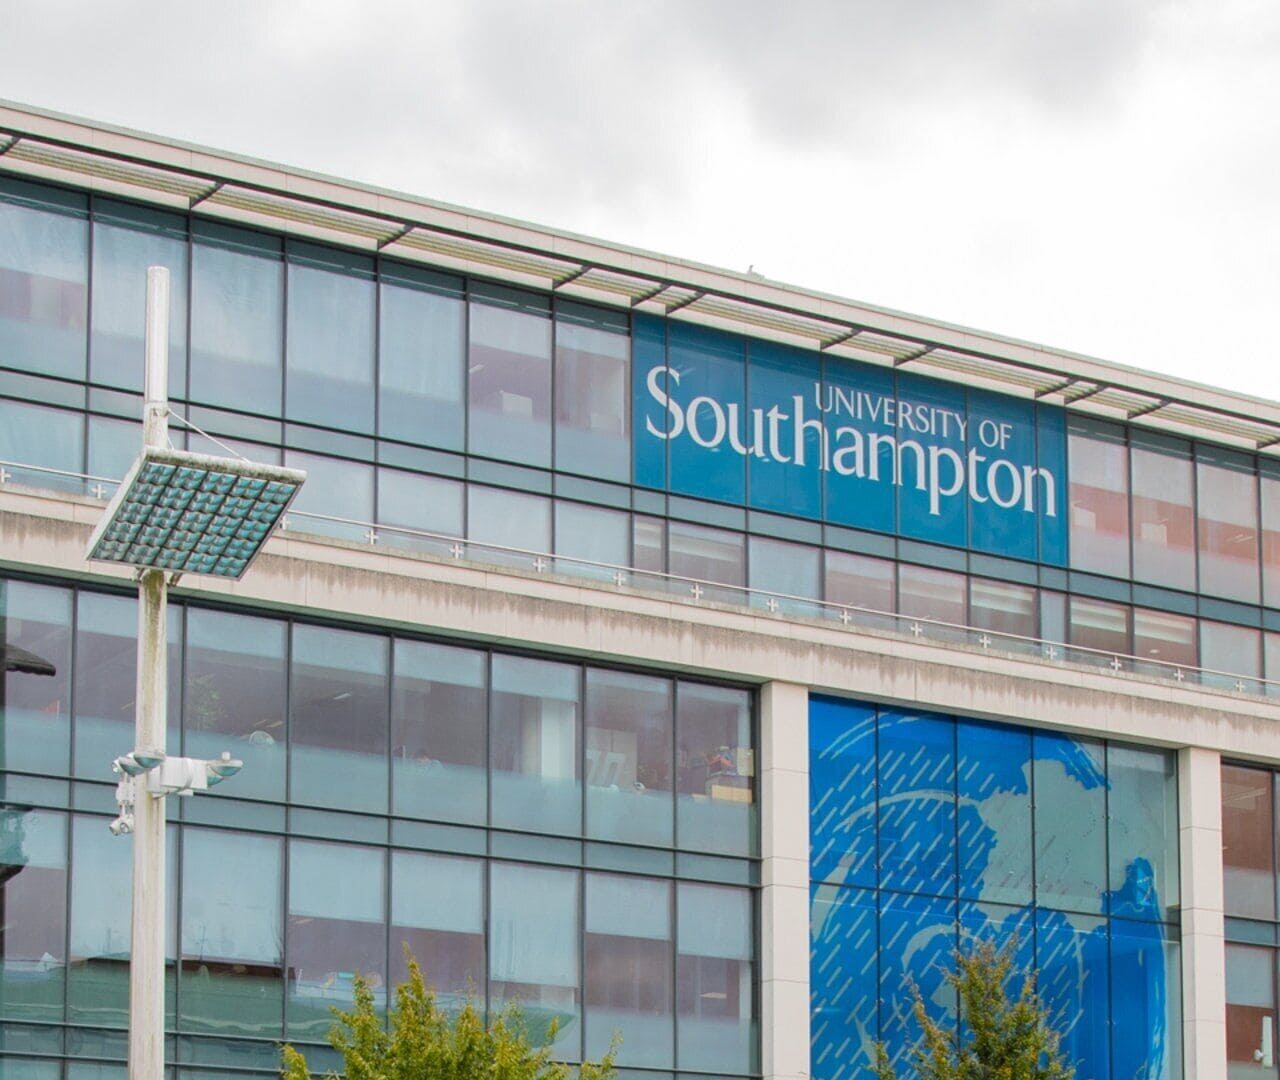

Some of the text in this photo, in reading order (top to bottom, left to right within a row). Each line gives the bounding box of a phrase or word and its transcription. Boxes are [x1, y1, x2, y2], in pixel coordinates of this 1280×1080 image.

[645, 364, 1057, 517] Southampton
[814, 383, 1013, 451] UNIVERSITY OF
